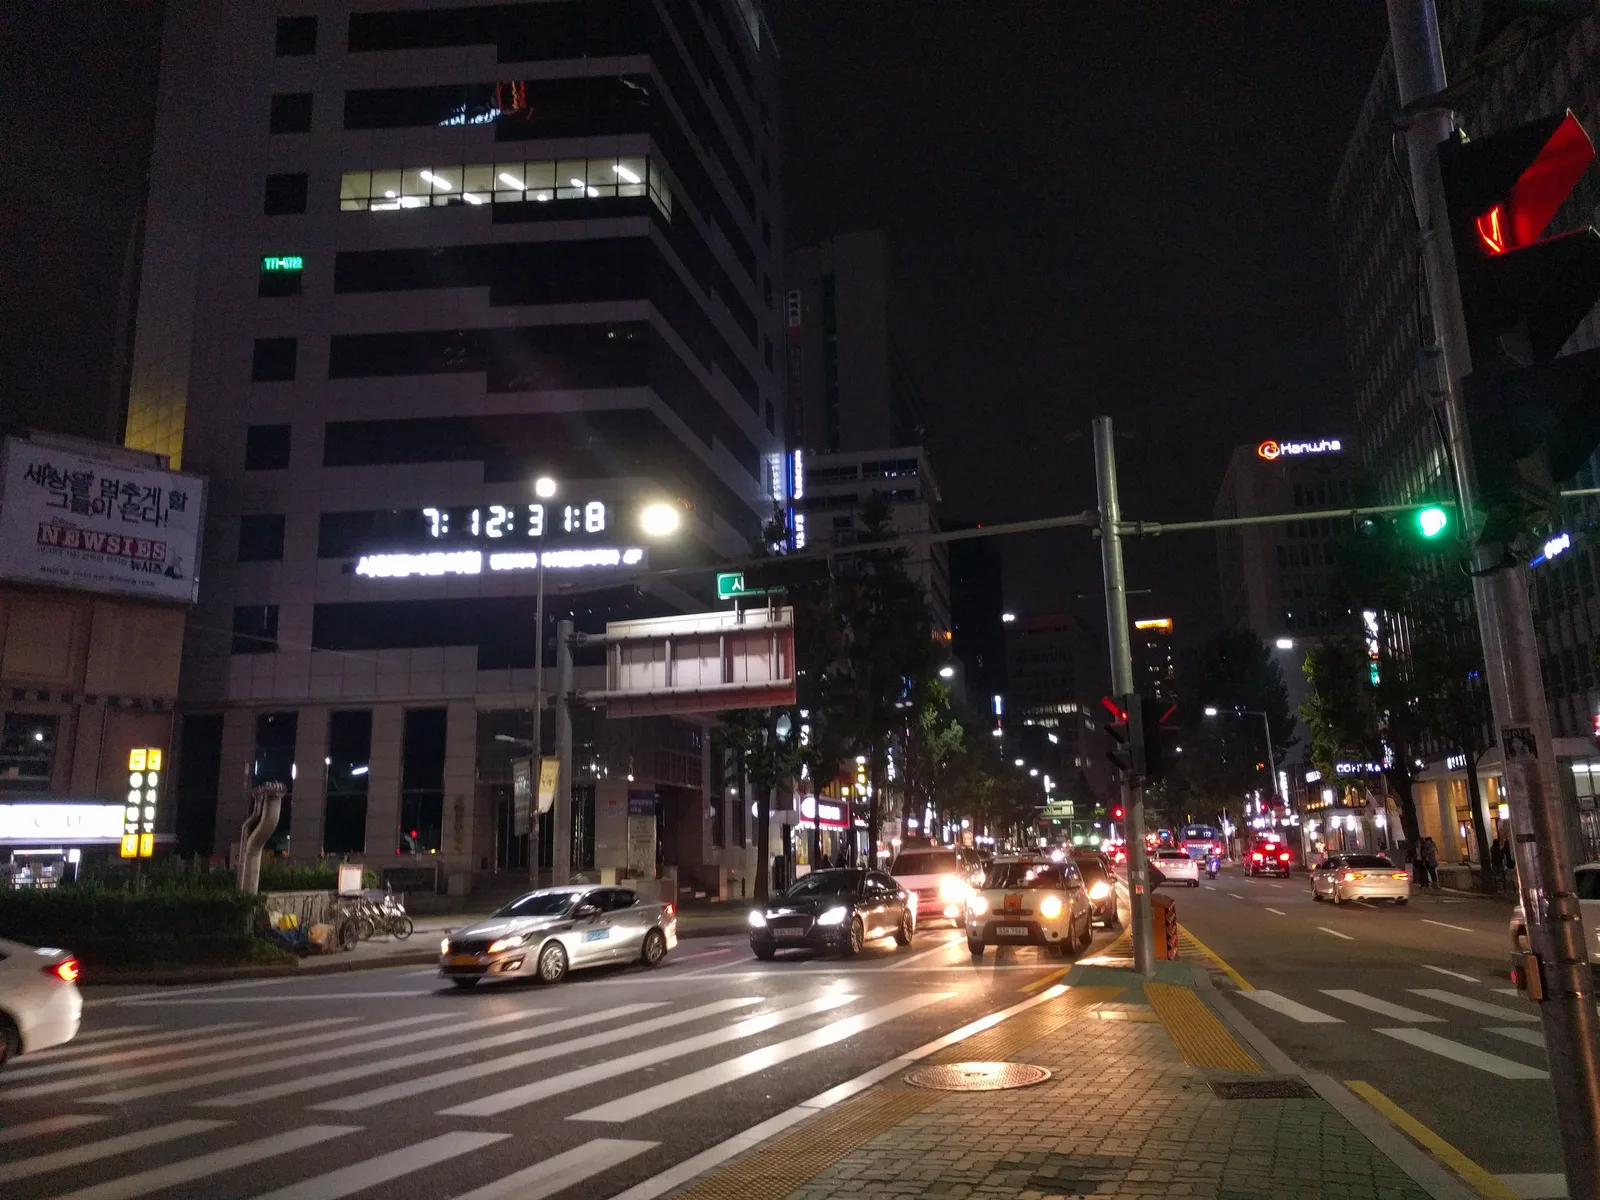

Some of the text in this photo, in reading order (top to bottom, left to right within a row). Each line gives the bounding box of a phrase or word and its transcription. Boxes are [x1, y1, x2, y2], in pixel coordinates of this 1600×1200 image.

[1280, 439, 1341, 455] Hanwha
[24, 462, 95, 496] 세상을
[100, 477, 162, 506] 멈추게
[46, 490, 113, 520] 그들이
[39, 523, 167, 562] NEWSIES
